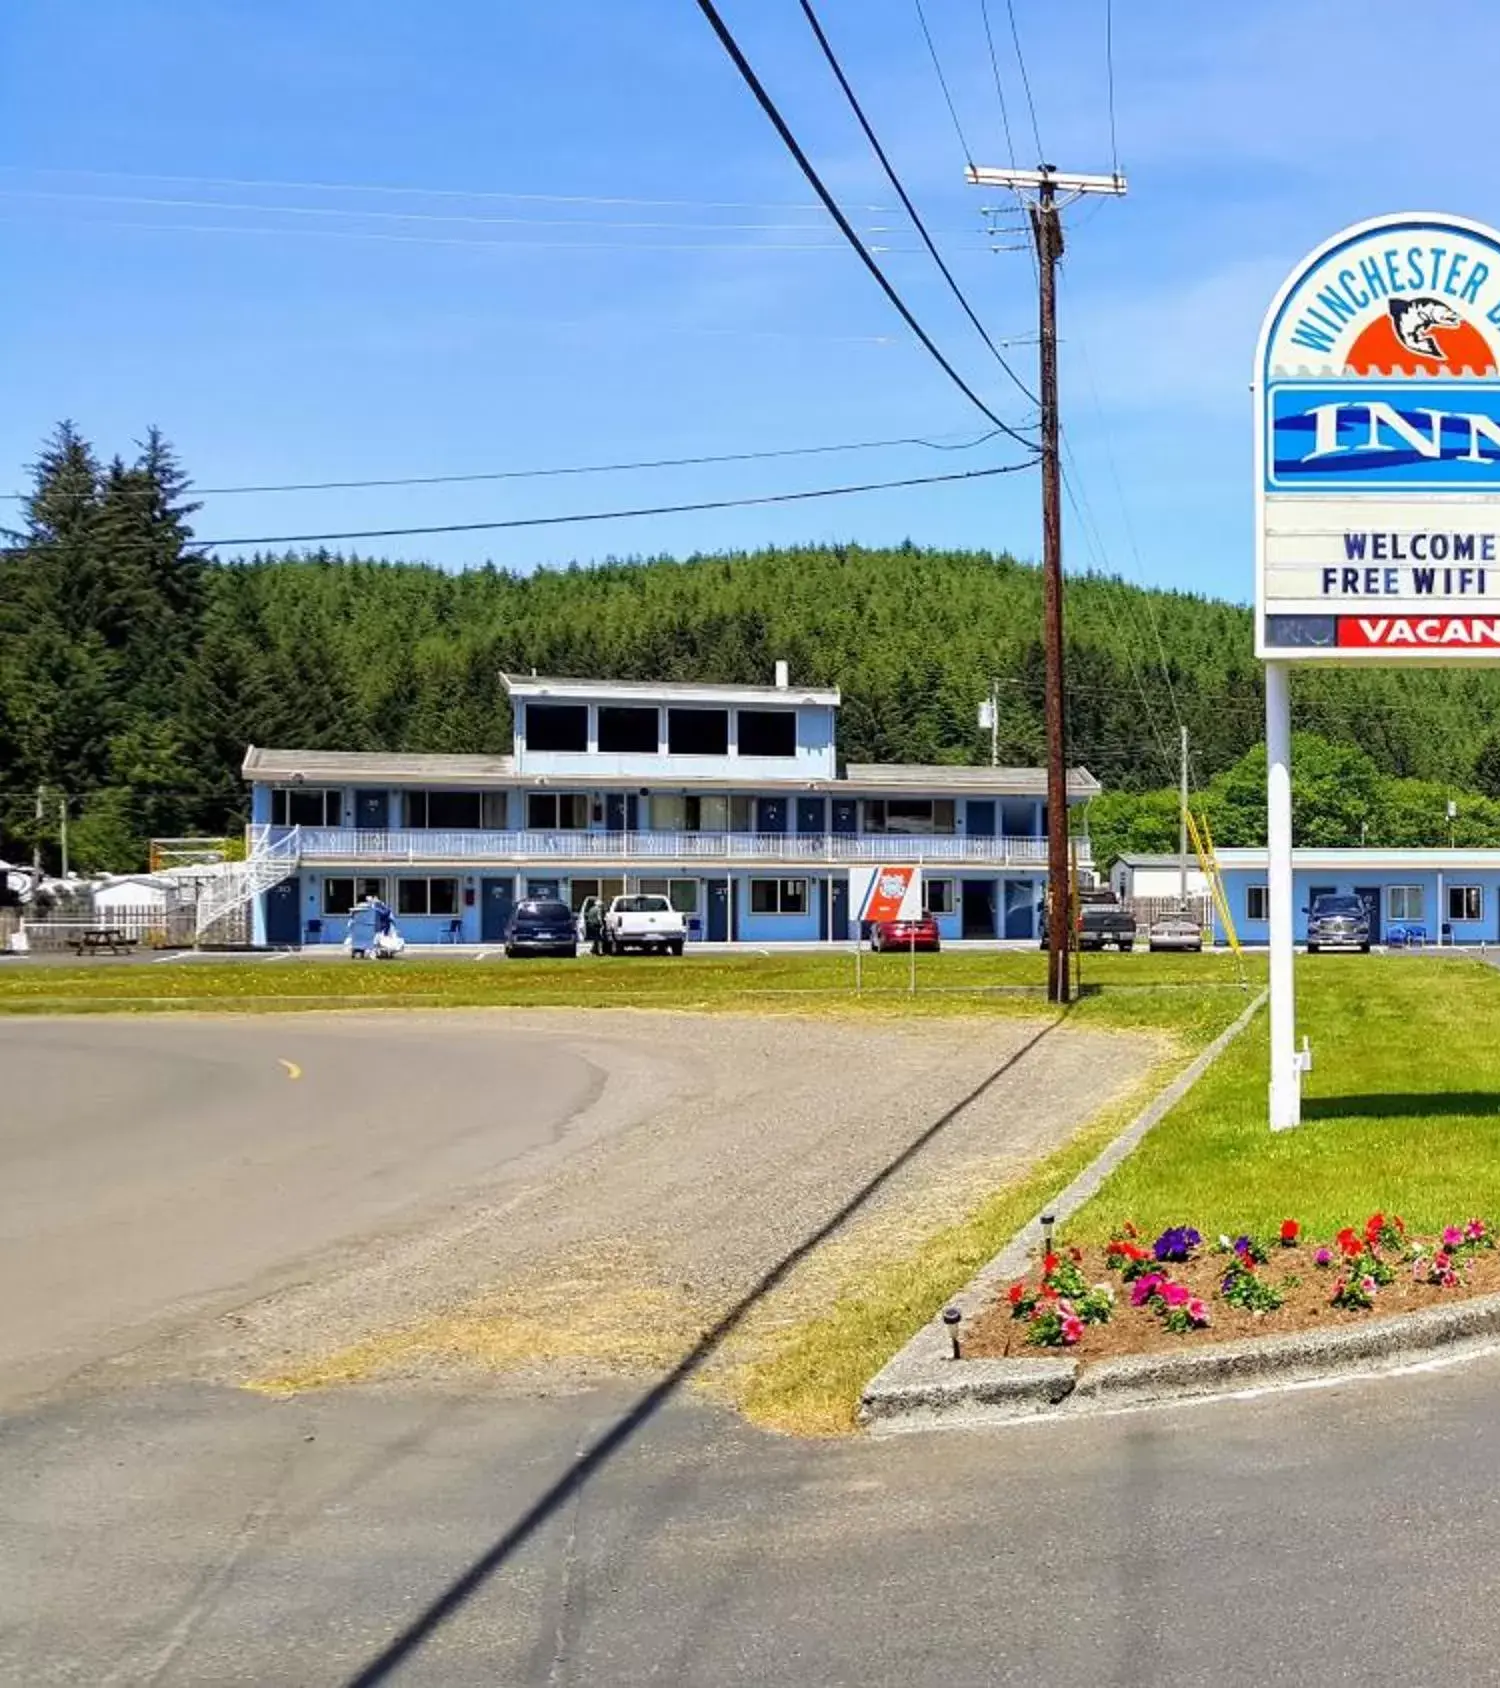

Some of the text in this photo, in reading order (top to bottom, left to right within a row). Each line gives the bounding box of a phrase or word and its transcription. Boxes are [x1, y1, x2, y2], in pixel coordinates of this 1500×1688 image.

[1291, 247, 1489, 353] WINCHESTER
[1343, 533, 1496, 561] WELCOME
[1322, 568, 1485, 594] FREE WIFI
